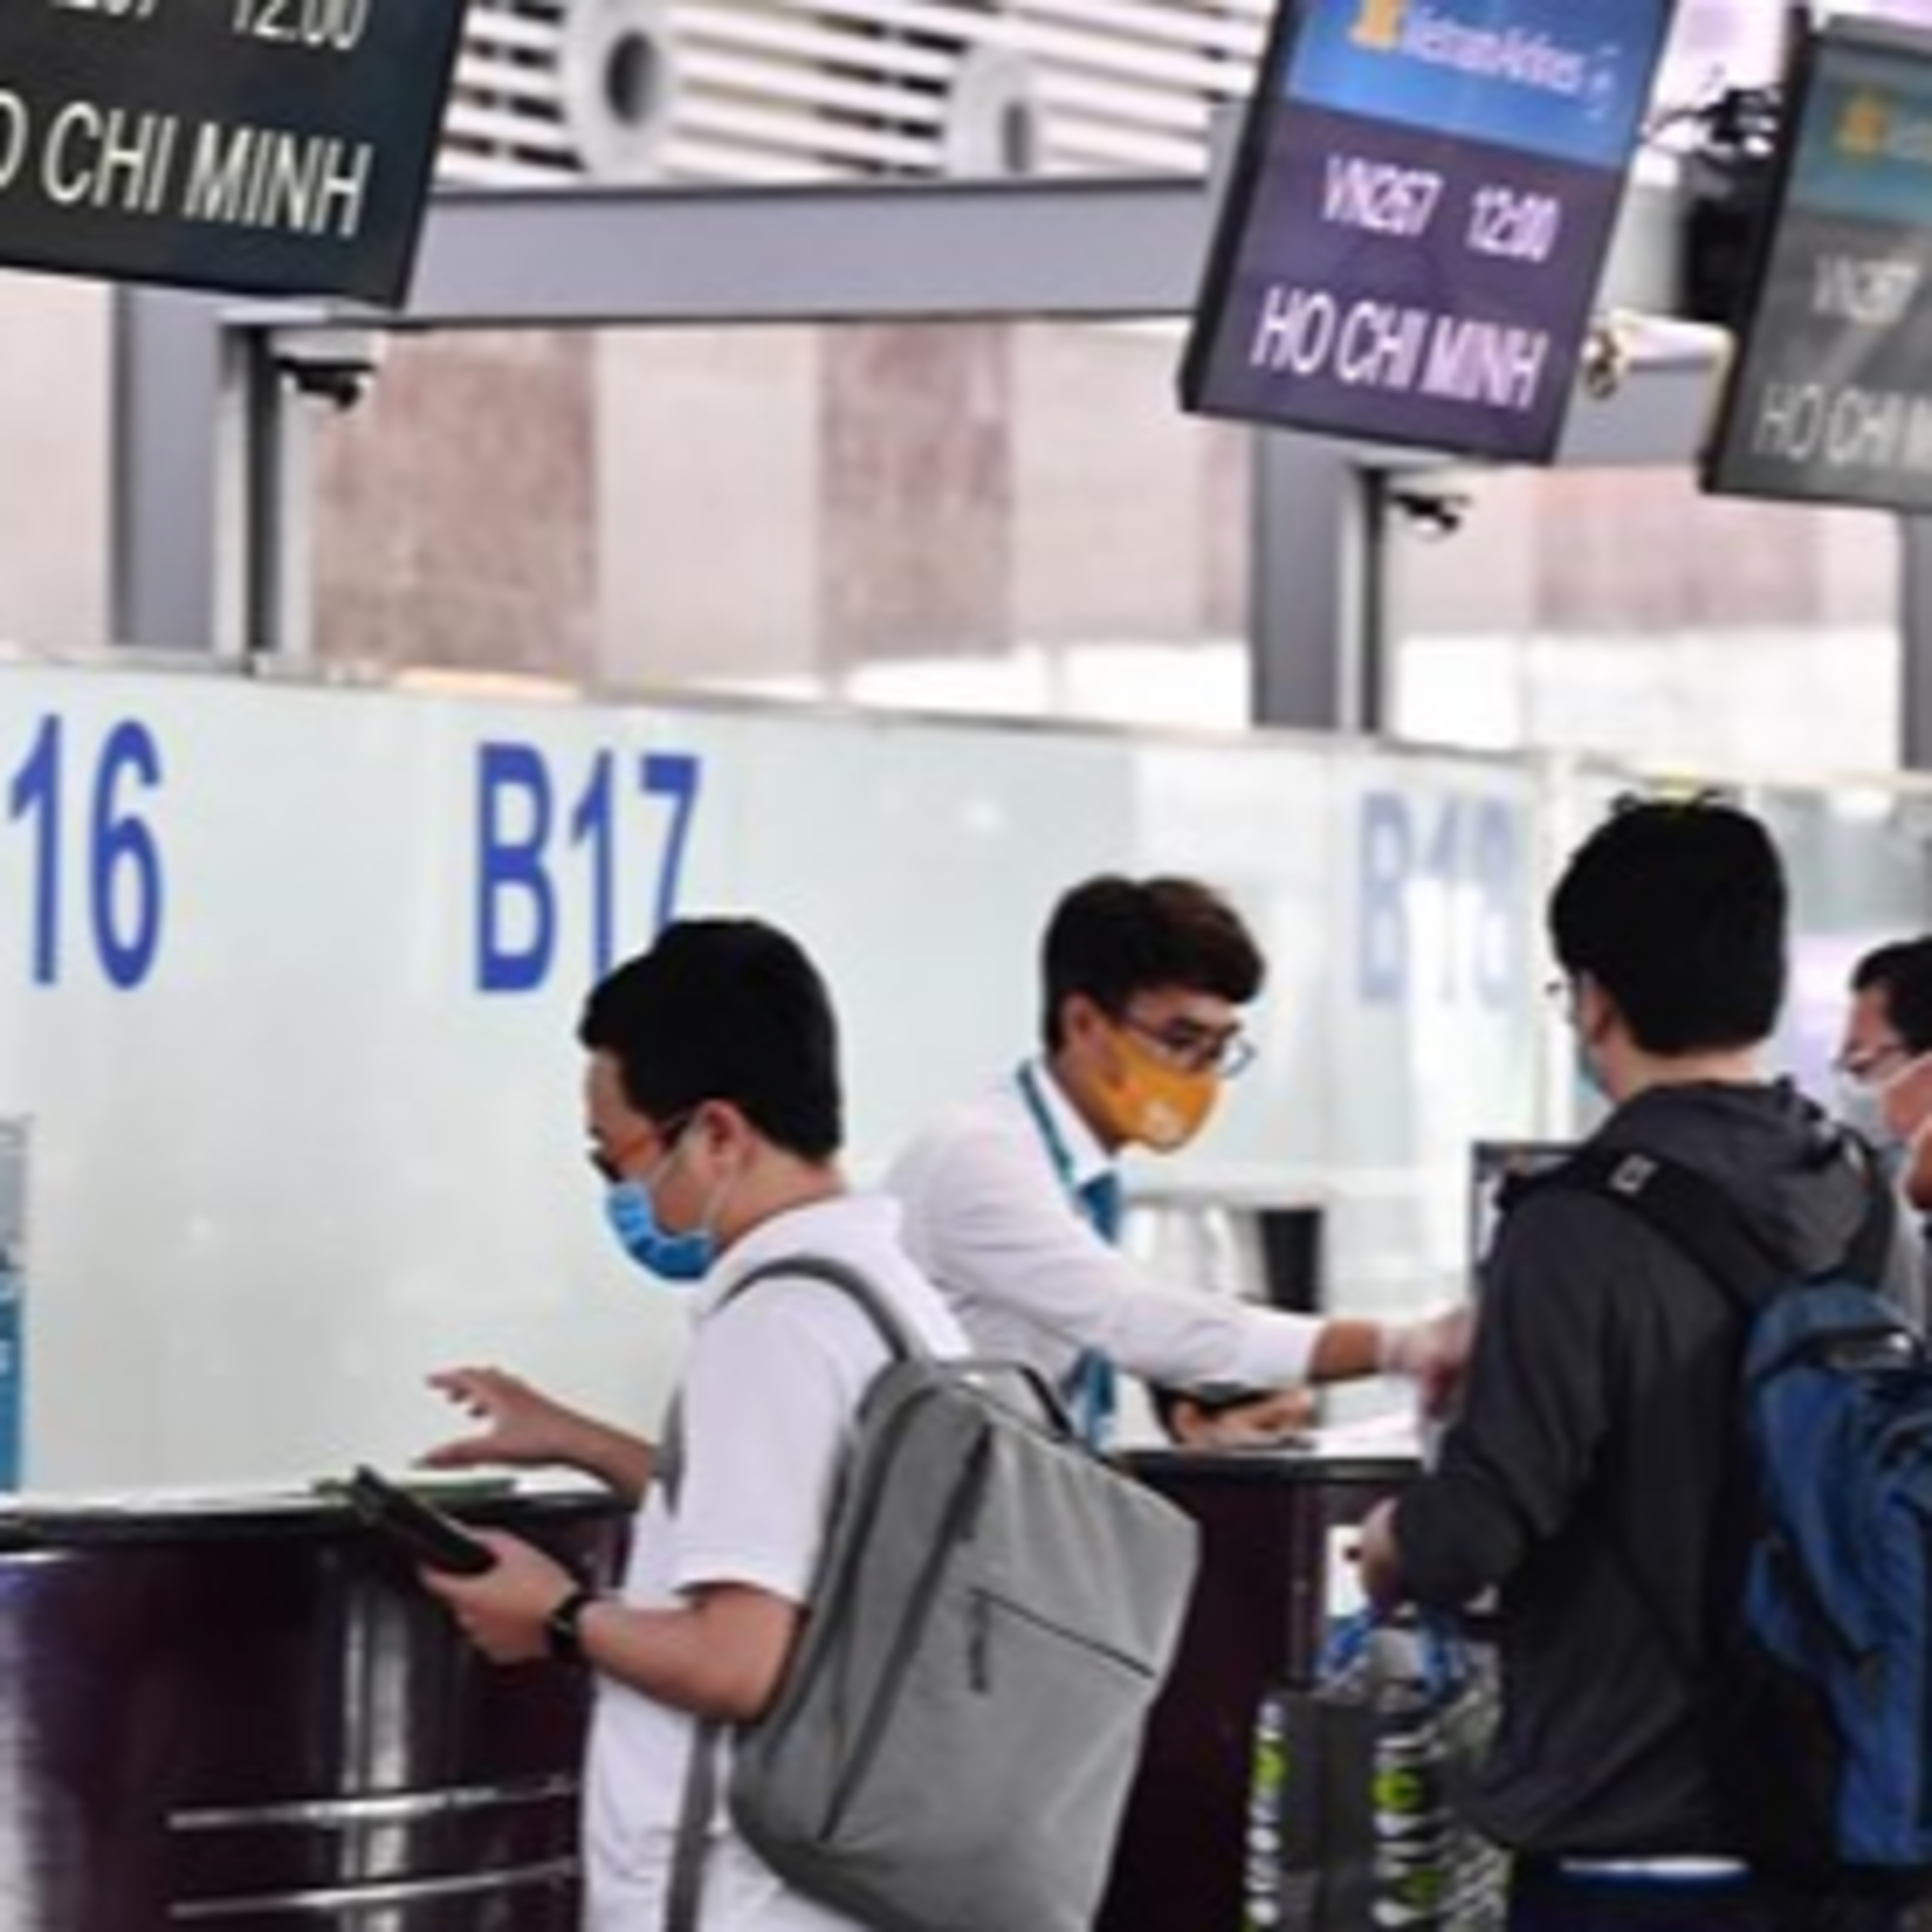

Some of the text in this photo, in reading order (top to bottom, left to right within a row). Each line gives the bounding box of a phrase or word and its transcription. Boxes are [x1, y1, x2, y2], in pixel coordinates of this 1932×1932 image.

[41, 100, 178, 214] CHI
[183, 121, 373, 240] MINH
[1250, 285, 1549, 411] HO CHI MINH
[1752, 381, 1824, 461] HO
[477, 741, 701, 992] B17
